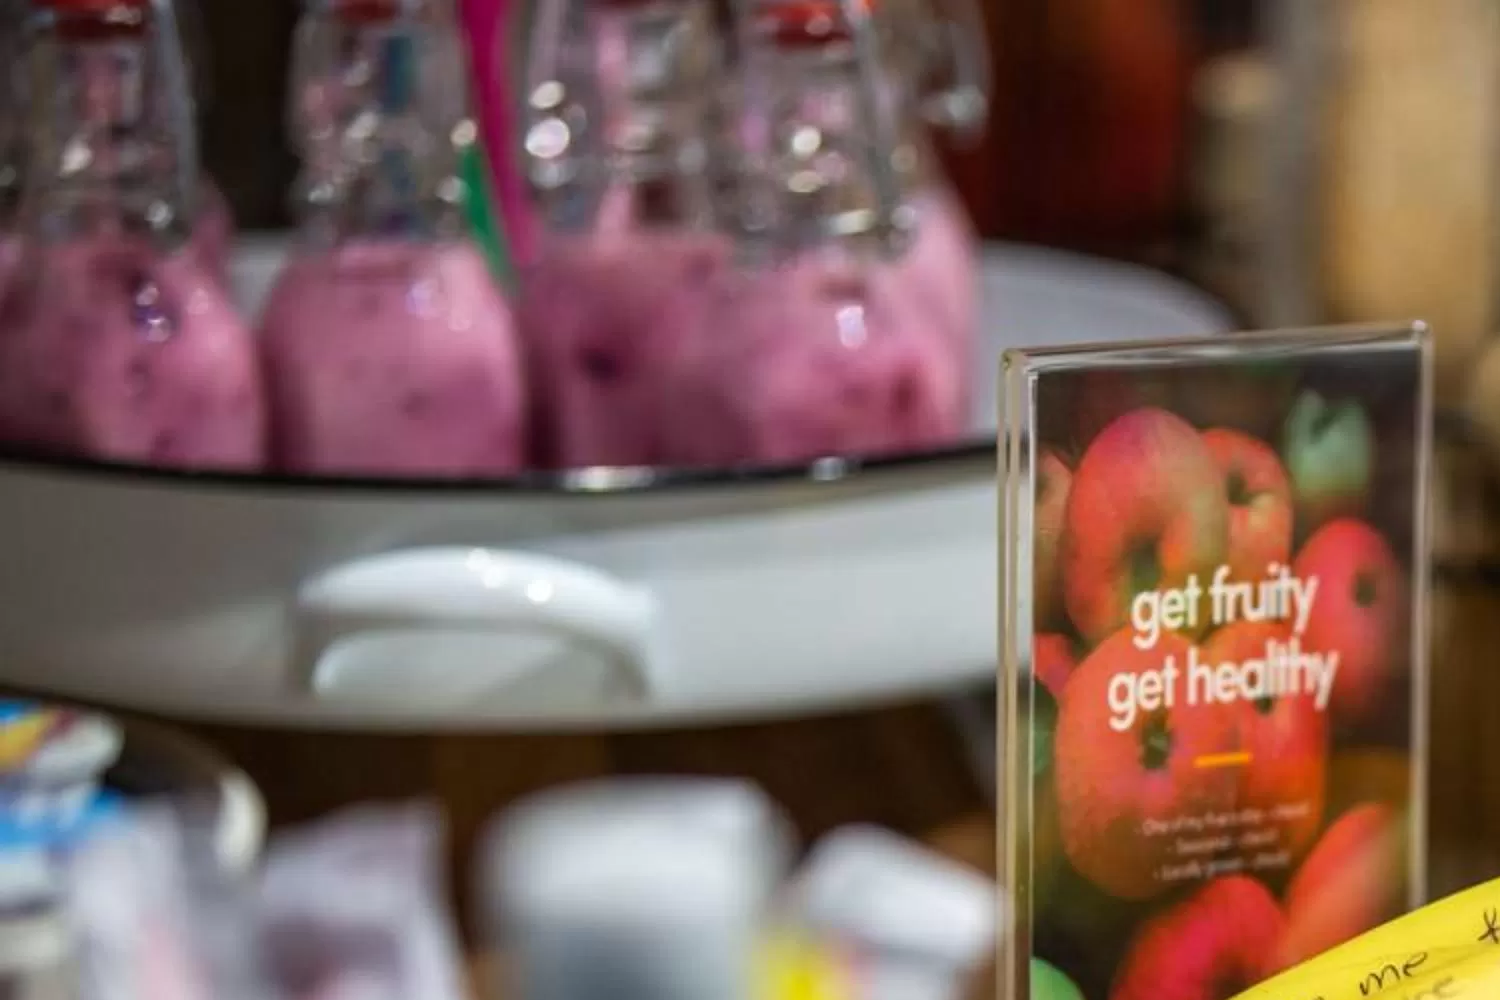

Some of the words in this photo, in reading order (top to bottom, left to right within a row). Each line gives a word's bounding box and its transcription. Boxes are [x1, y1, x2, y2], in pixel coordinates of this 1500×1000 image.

[1131, 573, 1202, 650] get
[1208, 562, 1319, 635] fruity
[1107, 655, 1180, 731] get
[1187, 637, 1340, 711] healthy
[1358, 951, 1430, 993] me
